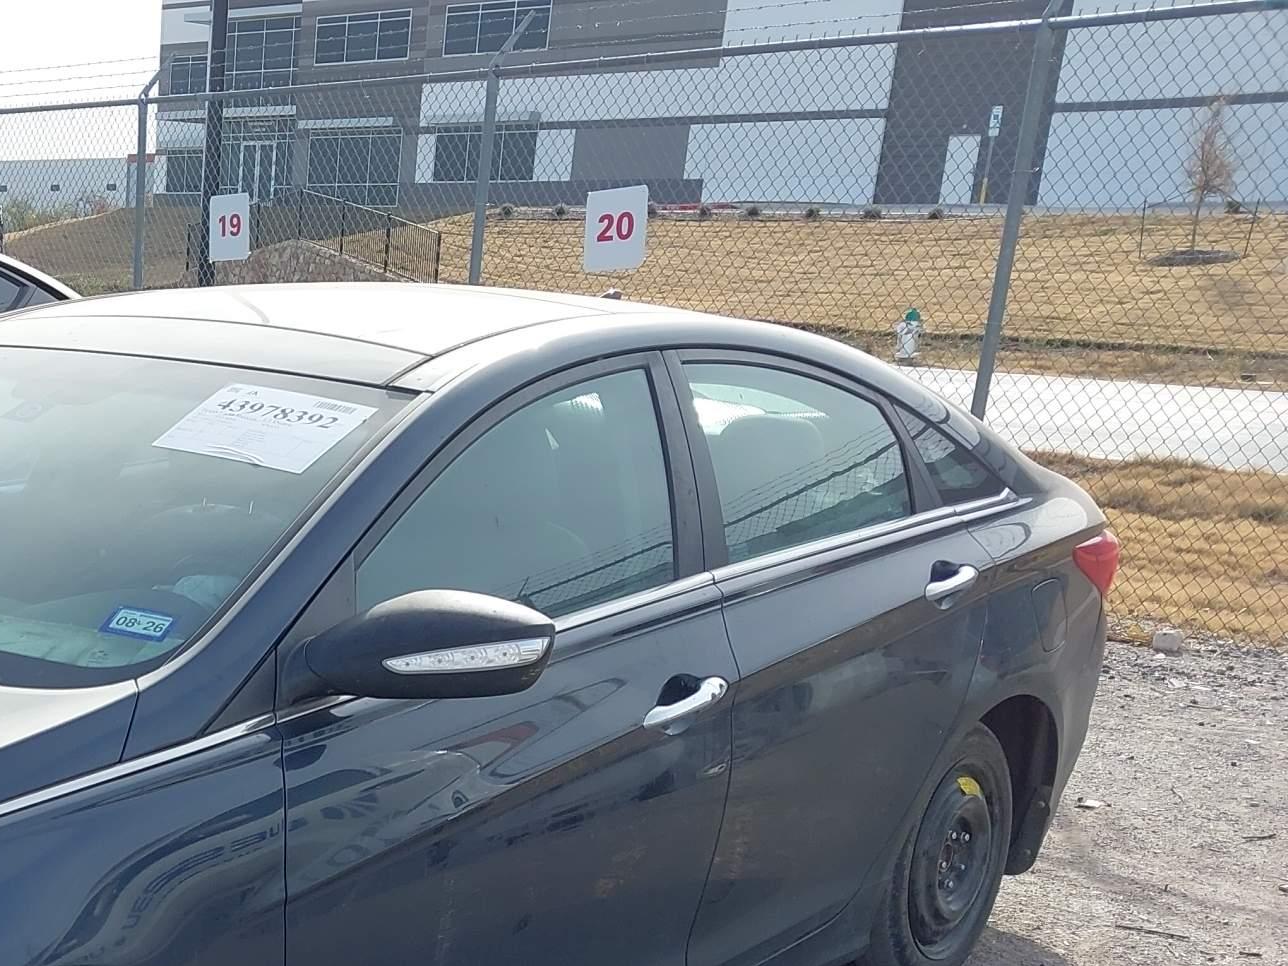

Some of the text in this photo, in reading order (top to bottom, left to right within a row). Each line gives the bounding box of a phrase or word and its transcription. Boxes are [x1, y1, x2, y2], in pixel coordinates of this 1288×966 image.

[218, 213, 242, 238] 19
[596, 211, 635, 243] 20
[217, 398, 339, 430] 43978392
[115, 616, 166, 633] 08 26
